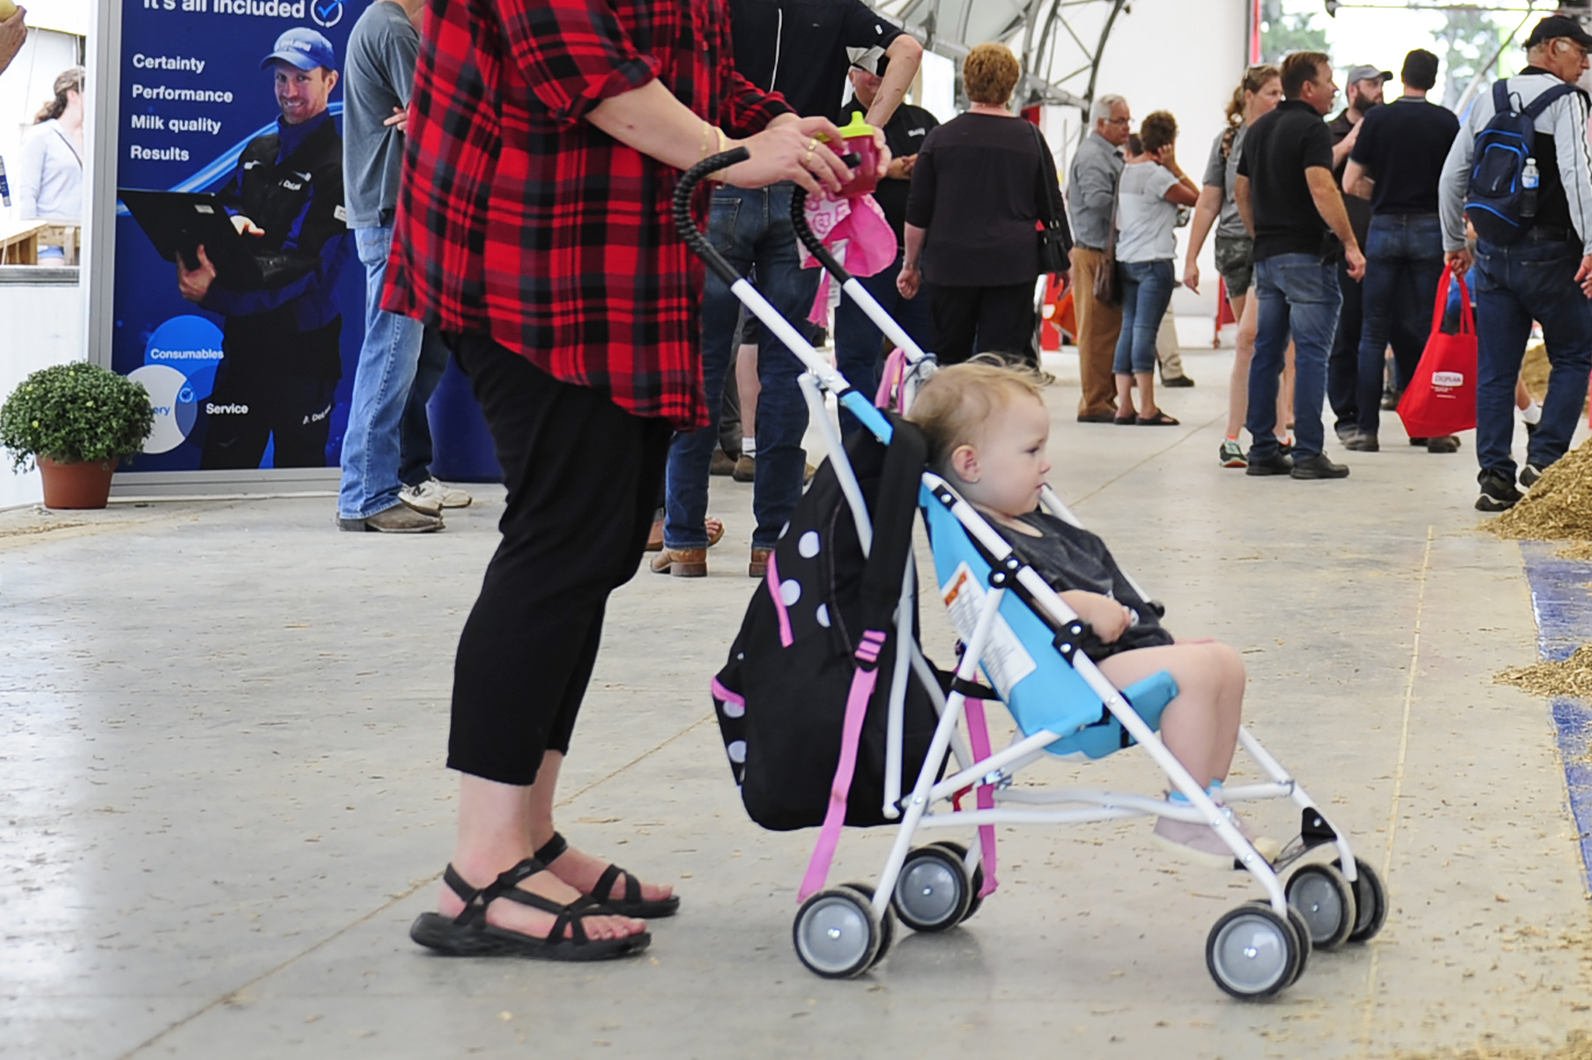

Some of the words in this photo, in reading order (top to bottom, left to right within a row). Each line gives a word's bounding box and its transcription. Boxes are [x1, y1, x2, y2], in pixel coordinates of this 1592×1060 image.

[132, 53, 206, 74] Certainty
[132, 84, 234, 103] Performance
[131, 114, 165, 130] Milk
[168, 117, 222, 135] quality
[130, 145, 190, 161] Results
[150, 348, 225, 360] Consumables
[205, 403, 249, 415] Service
